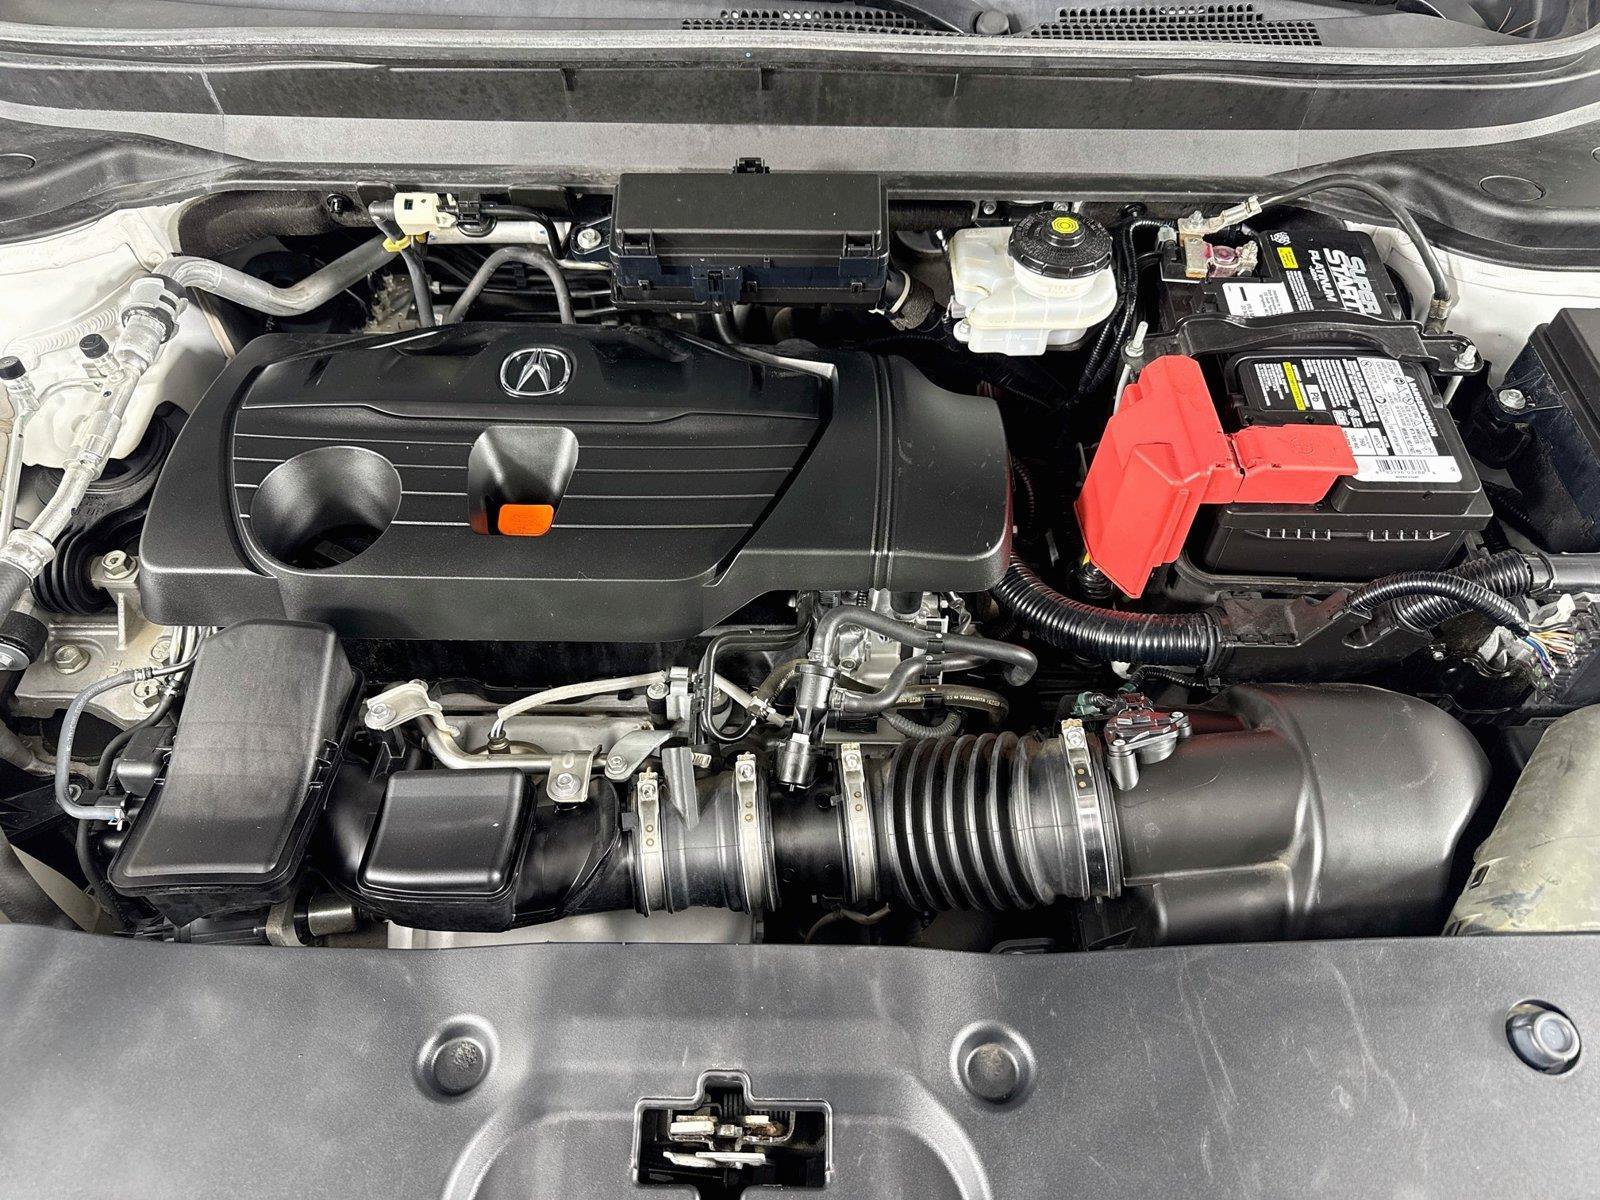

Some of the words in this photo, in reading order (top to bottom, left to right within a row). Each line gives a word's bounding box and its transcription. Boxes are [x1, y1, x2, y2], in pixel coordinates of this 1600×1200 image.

[1307, 249, 1338, 303] PLATINUM
[1322, 247, 1366, 315] START
[1349, 255, 1382, 315] SUPER
[1310, 391, 1320, 403] Pb
